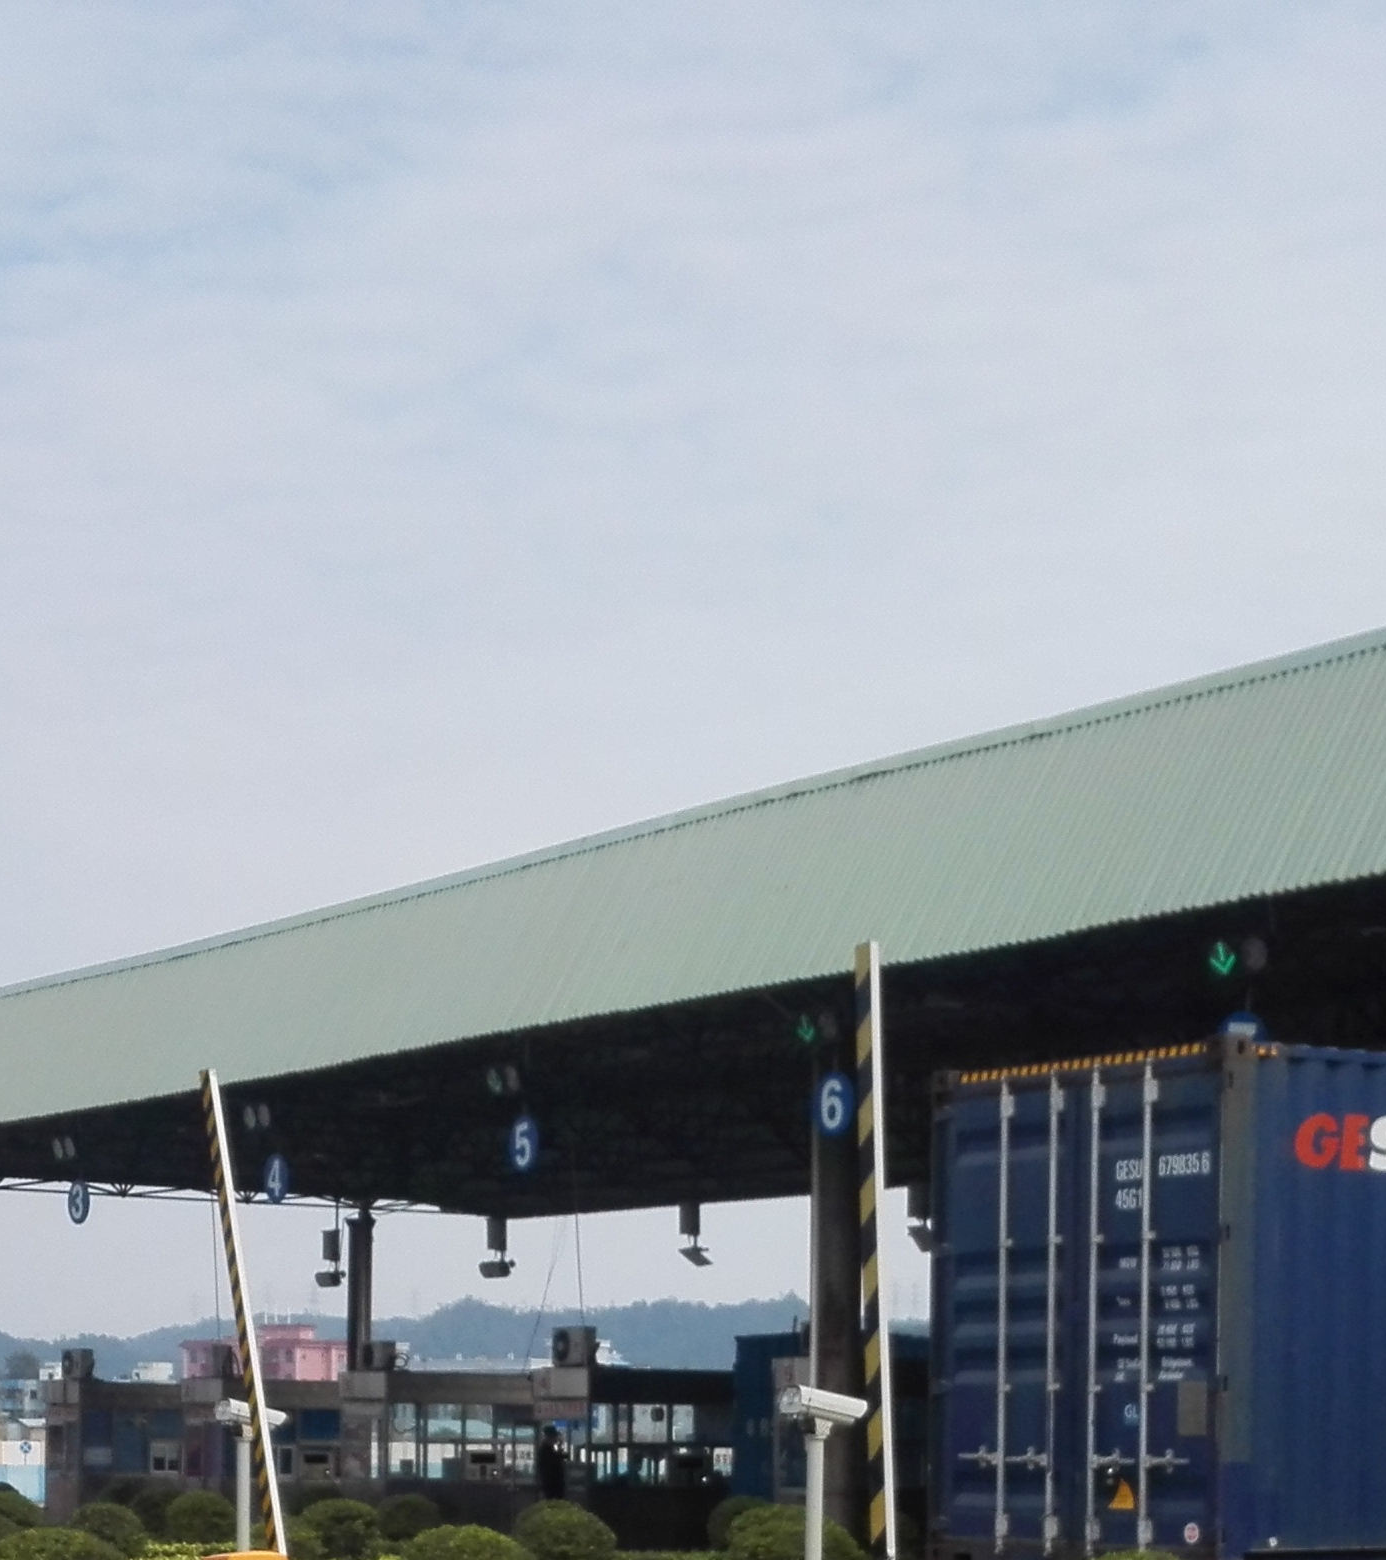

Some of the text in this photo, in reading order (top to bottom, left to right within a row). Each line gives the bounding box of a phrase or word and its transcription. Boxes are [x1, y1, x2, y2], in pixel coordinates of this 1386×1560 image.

[821, 1078, 843, 1130] 6
[515, 1122, 530, 1167] 5
[268, 1157, 283, 1197] 4
[1116, 1158, 1144, 1181] GESU
[70, 1183, 83, 1220] 3
